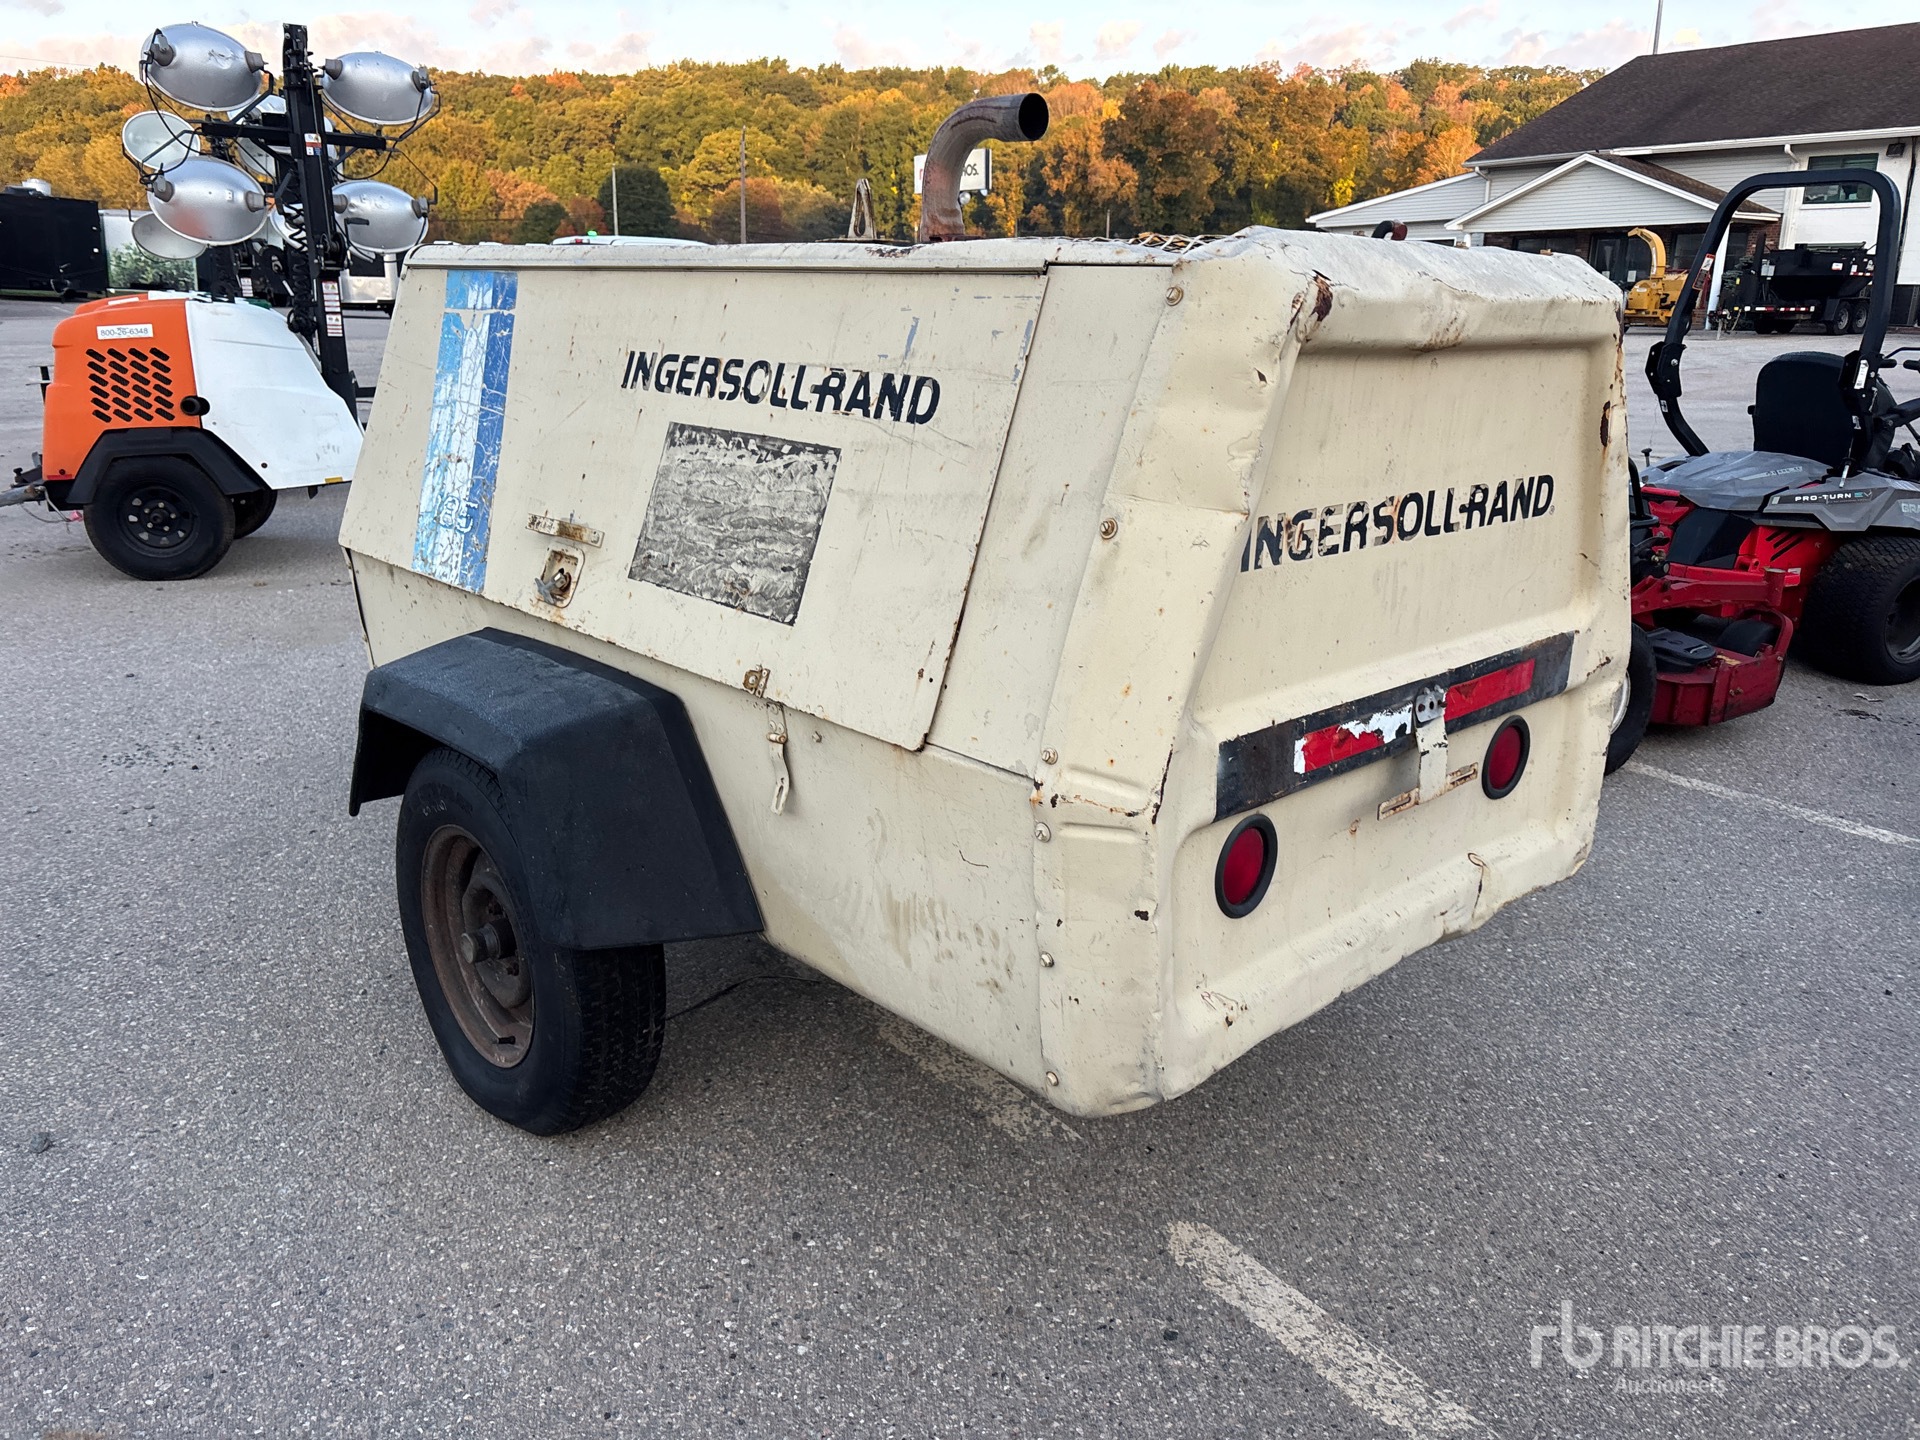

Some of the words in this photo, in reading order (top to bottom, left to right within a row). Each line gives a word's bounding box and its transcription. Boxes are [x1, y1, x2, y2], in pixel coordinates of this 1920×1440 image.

[621, 350, 941, 424] INGERSOLL-RAND
[1240, 474, 1555, 573] INGERSOLL-RAND
[1795, 493, 1852, 502] PRO-TURN
